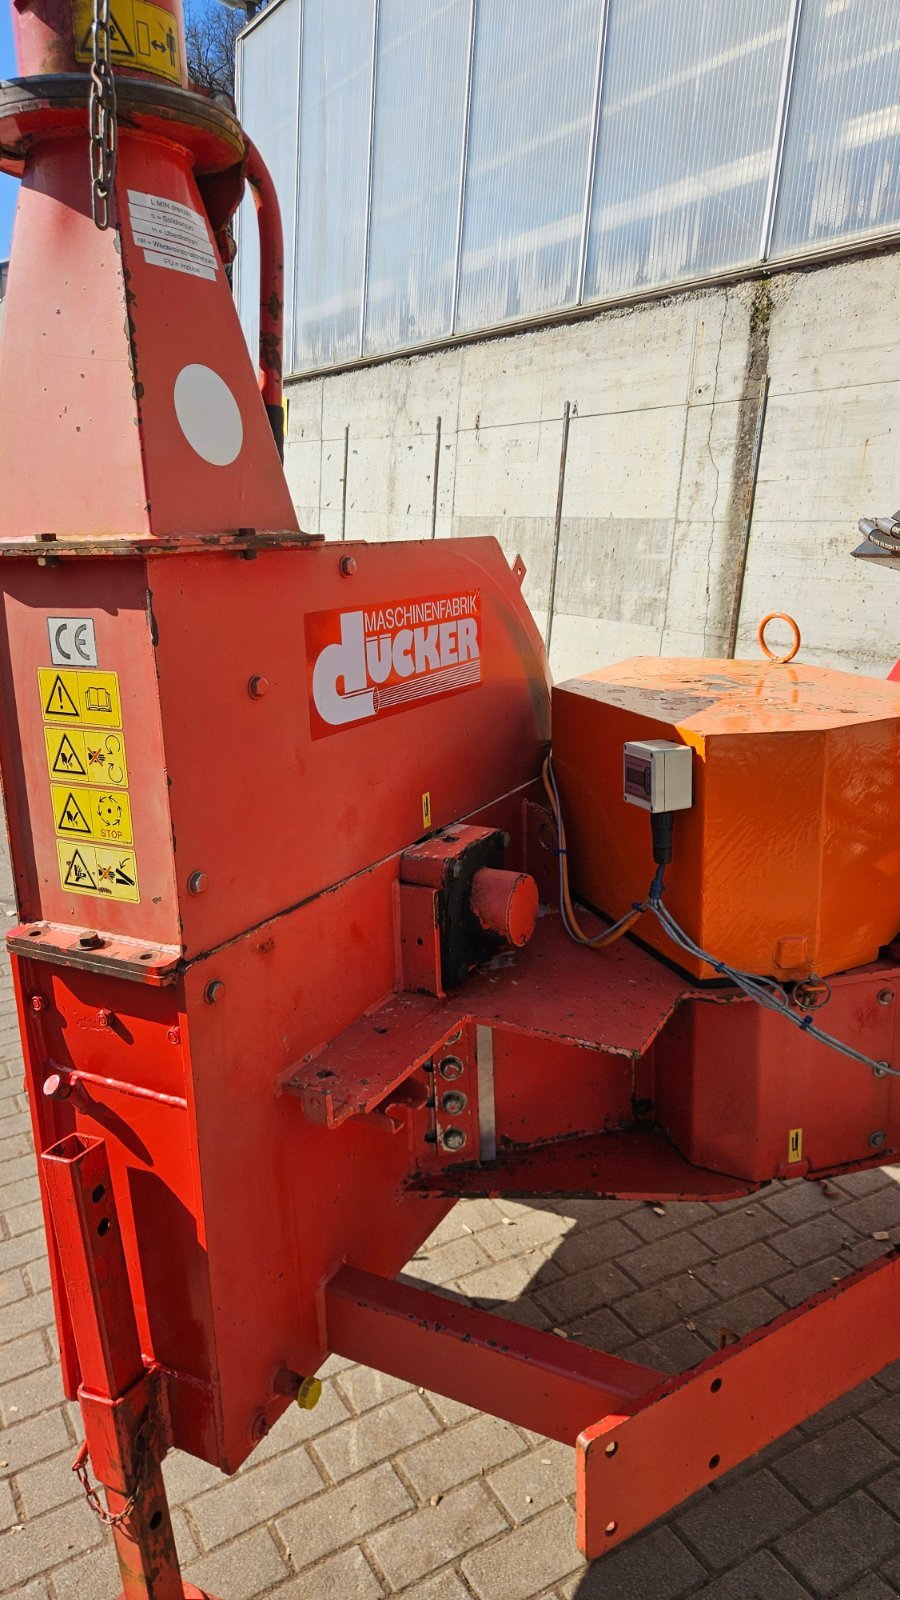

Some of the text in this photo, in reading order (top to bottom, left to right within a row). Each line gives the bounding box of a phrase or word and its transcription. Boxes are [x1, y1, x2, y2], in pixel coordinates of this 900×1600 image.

[156, 200, 170, 209] MIN
[364, 595, 478, 633] MASCHINENFABRIK
[55, 623, 91, 661] CE
[100, 828, 123, 839] STOP
